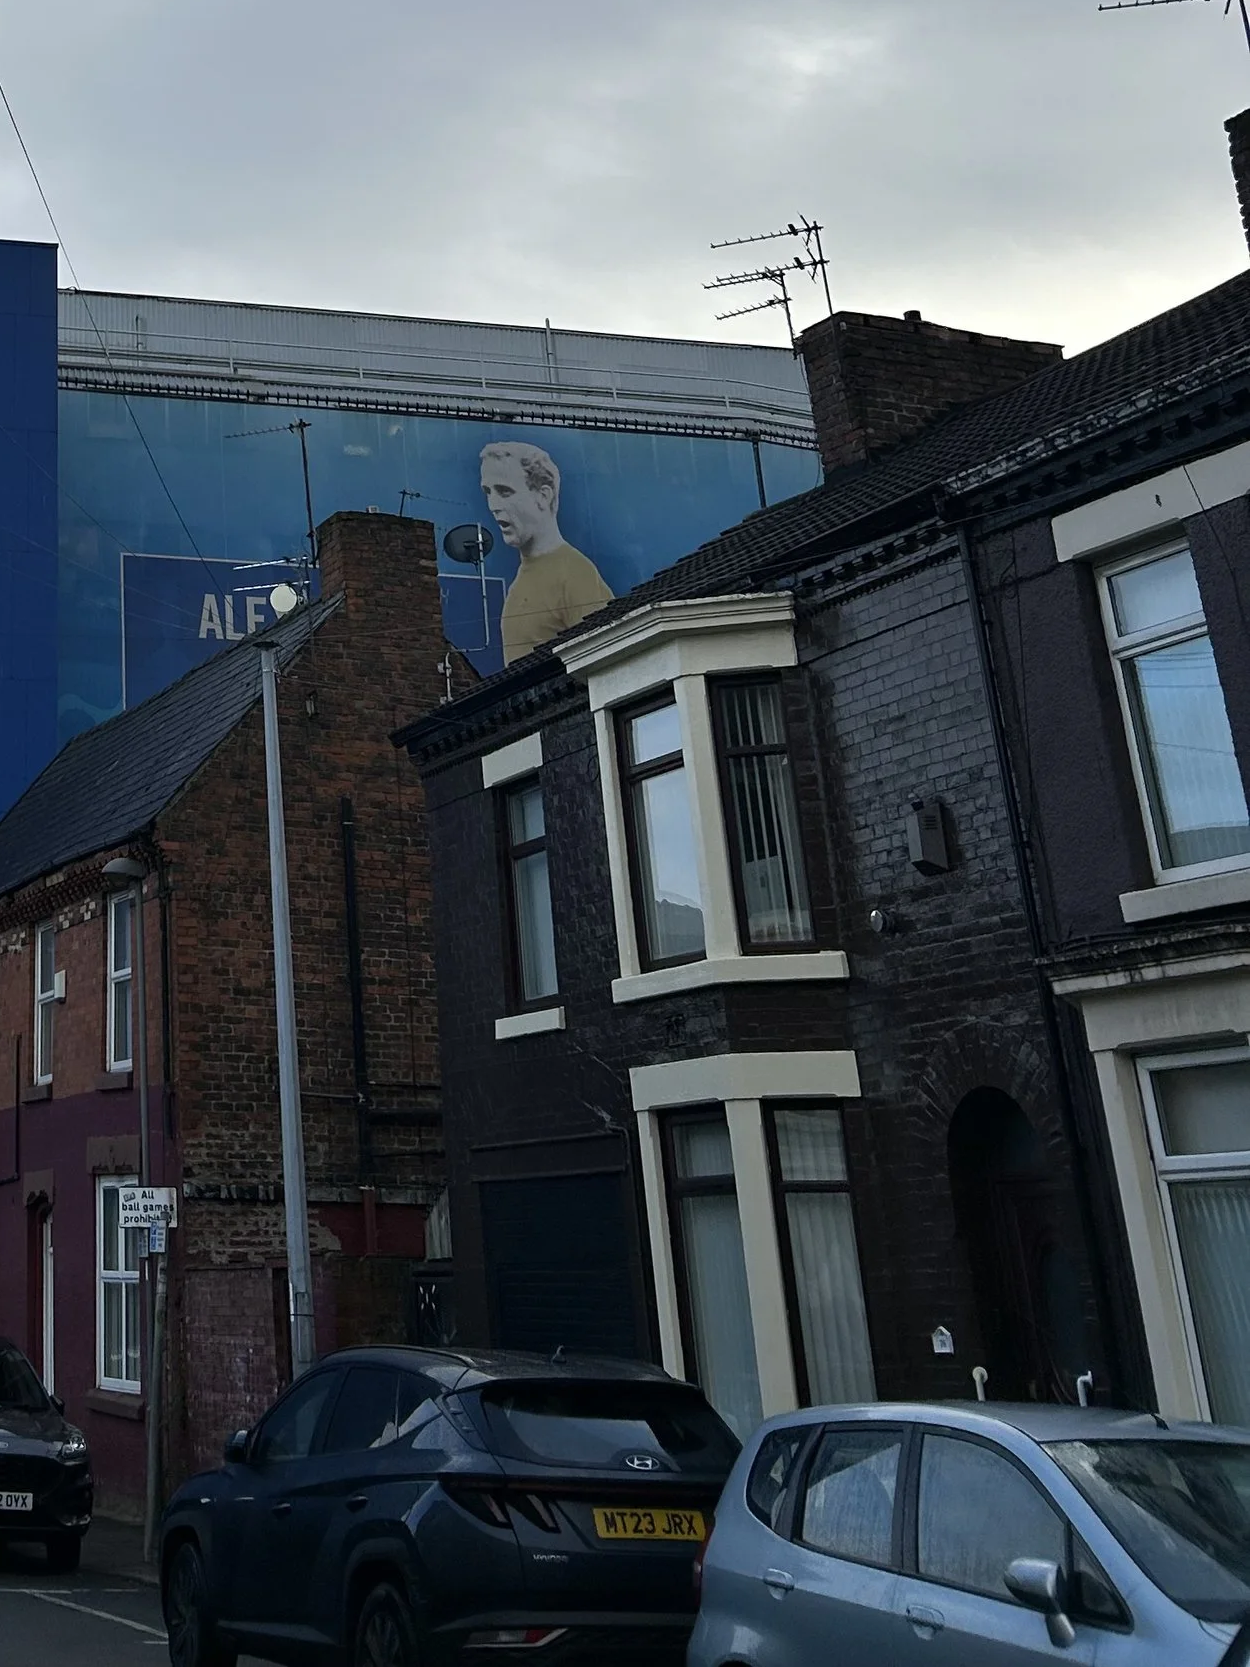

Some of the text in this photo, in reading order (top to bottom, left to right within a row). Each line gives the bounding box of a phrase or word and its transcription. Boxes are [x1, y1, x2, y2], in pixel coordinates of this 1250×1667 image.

[141, 1190, 154, 1199] All
[122, 1202, 174, 1212] ball games
[603, 1511, 698, 1536] MT23 JRX
